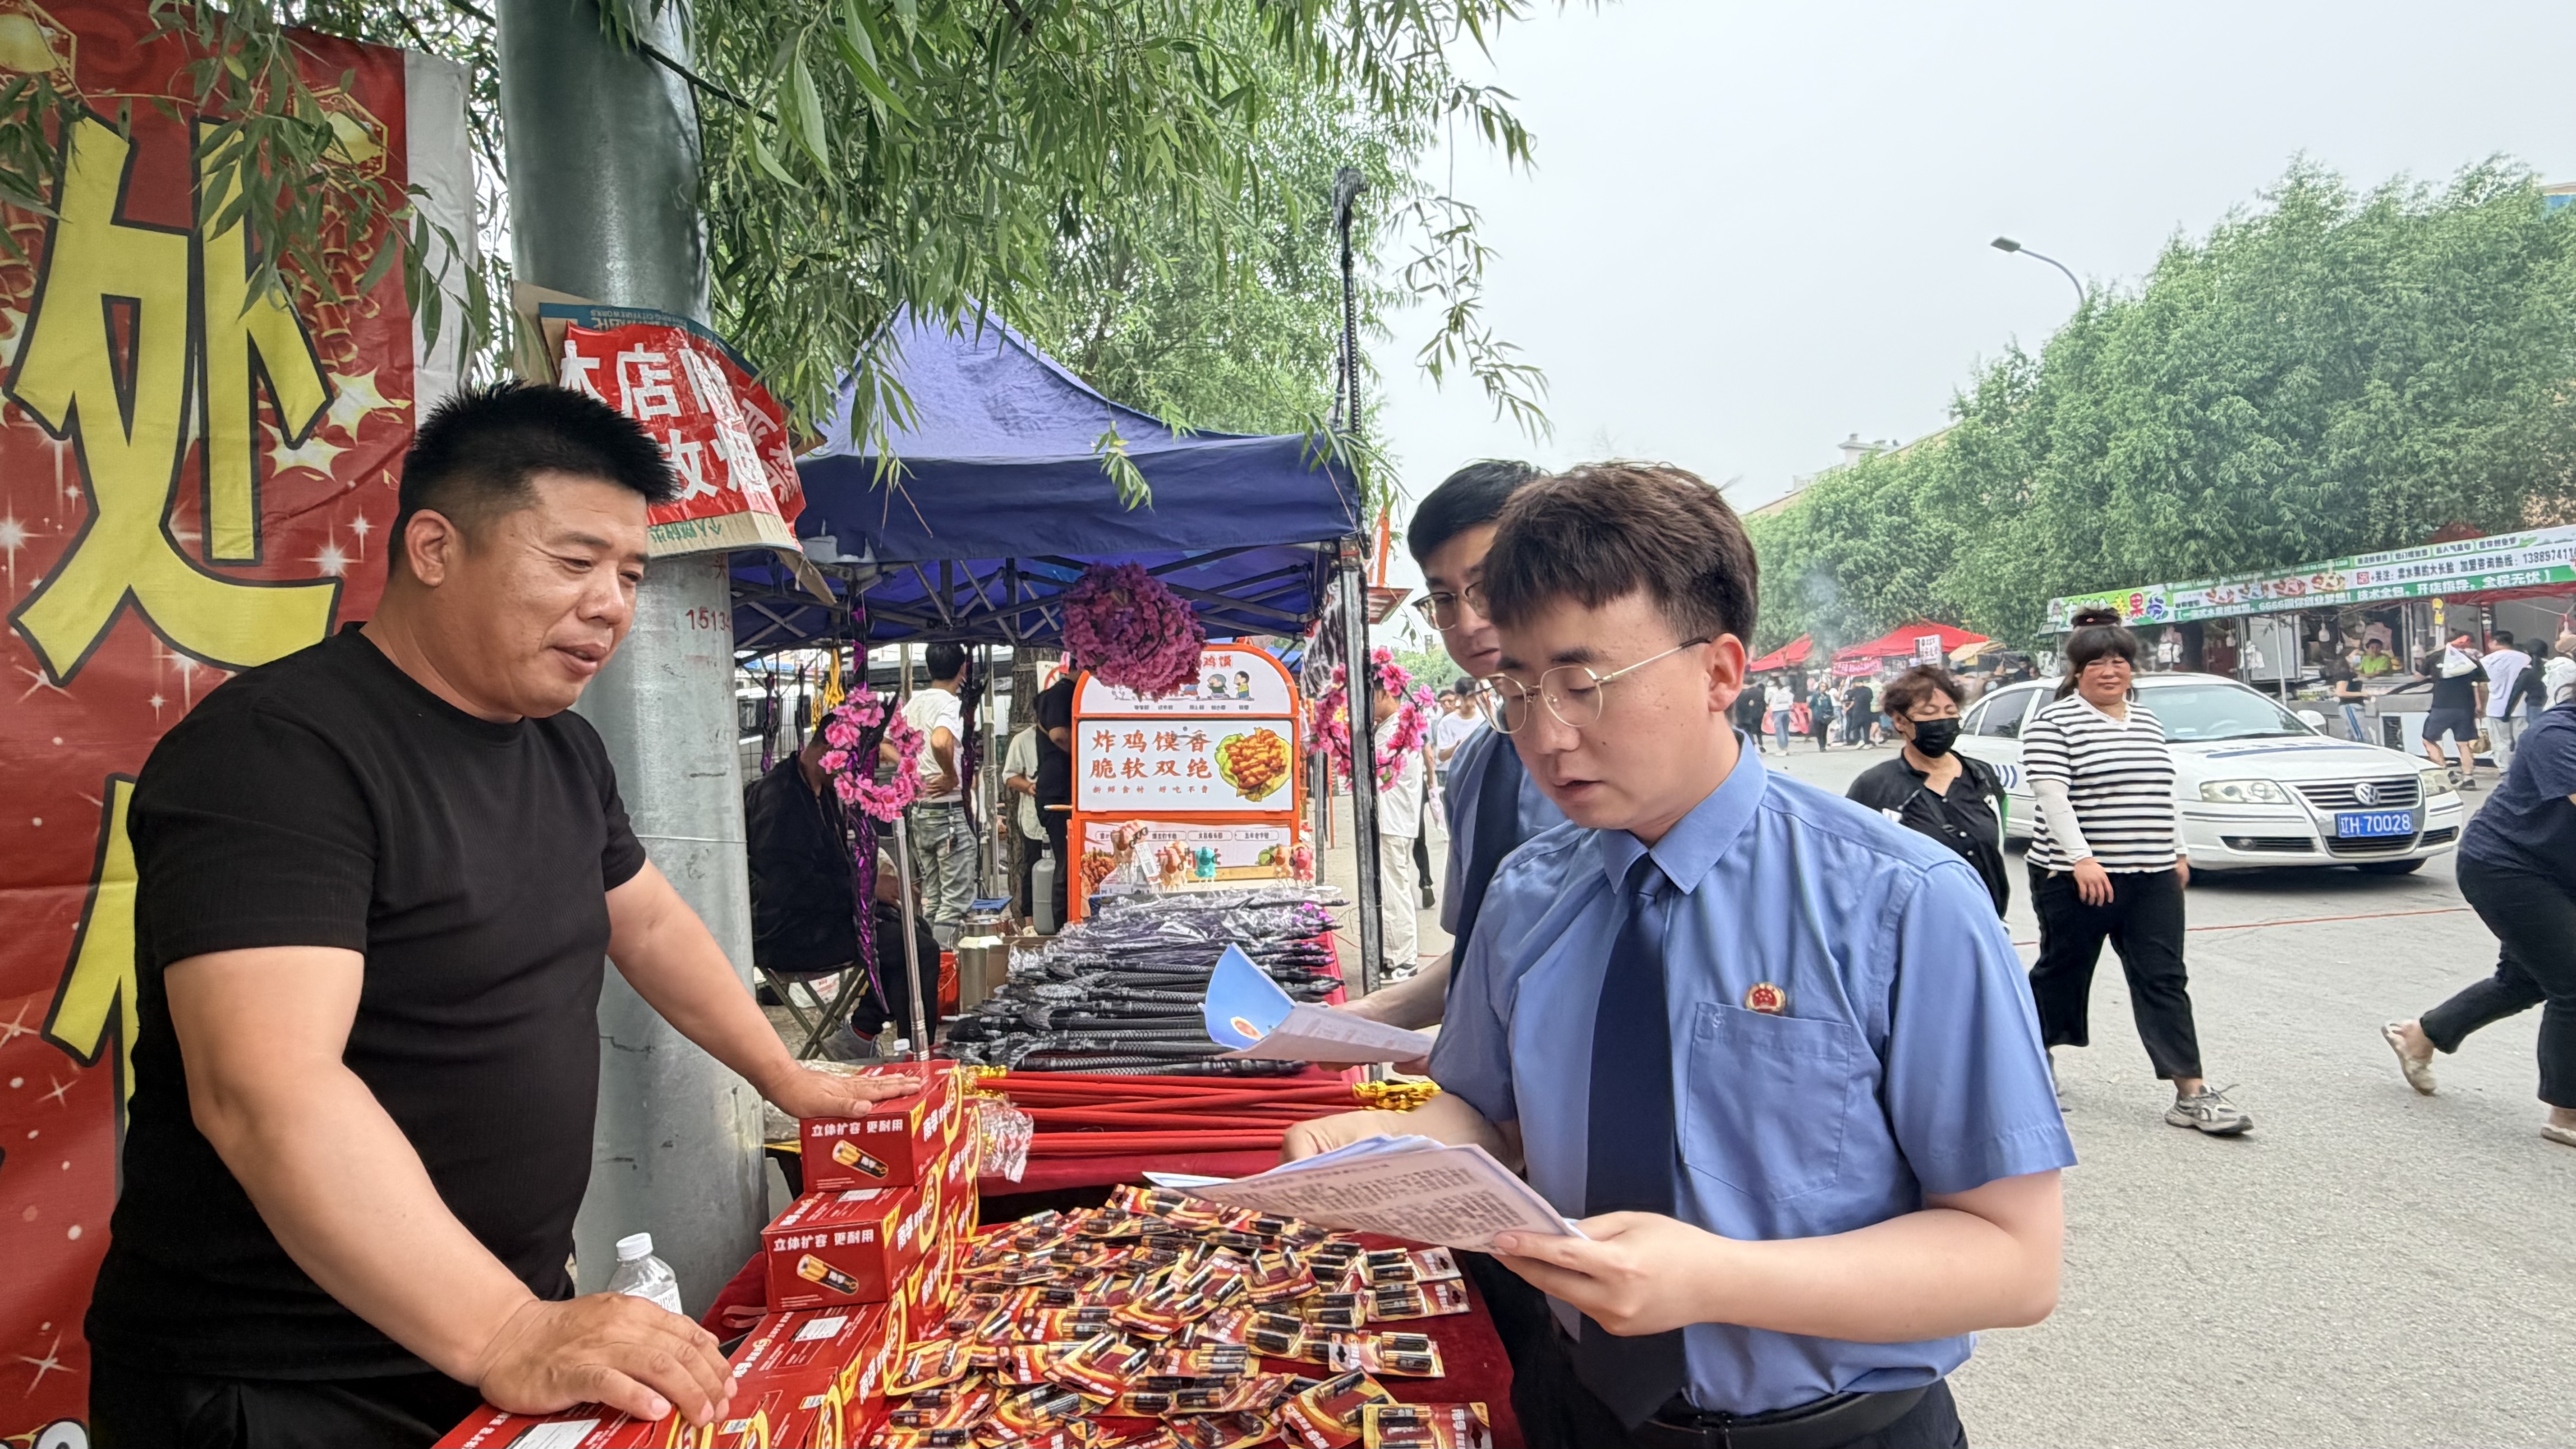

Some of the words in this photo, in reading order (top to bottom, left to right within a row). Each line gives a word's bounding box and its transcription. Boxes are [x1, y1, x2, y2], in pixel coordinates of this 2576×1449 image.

[4, 106, 342, 687] 处
[1091, 729, 1212, 753] 炸鸡馍香
[1089, 757, 1212, 779] 脆软双绝
[811, 1122, 861, 1137] 立体扩容
[866, 1118, 903, 1134] 更耐用
[773, 1233, 828, 1252] 立体扩容
[834, 1228, 874, 1246] 更耐用
